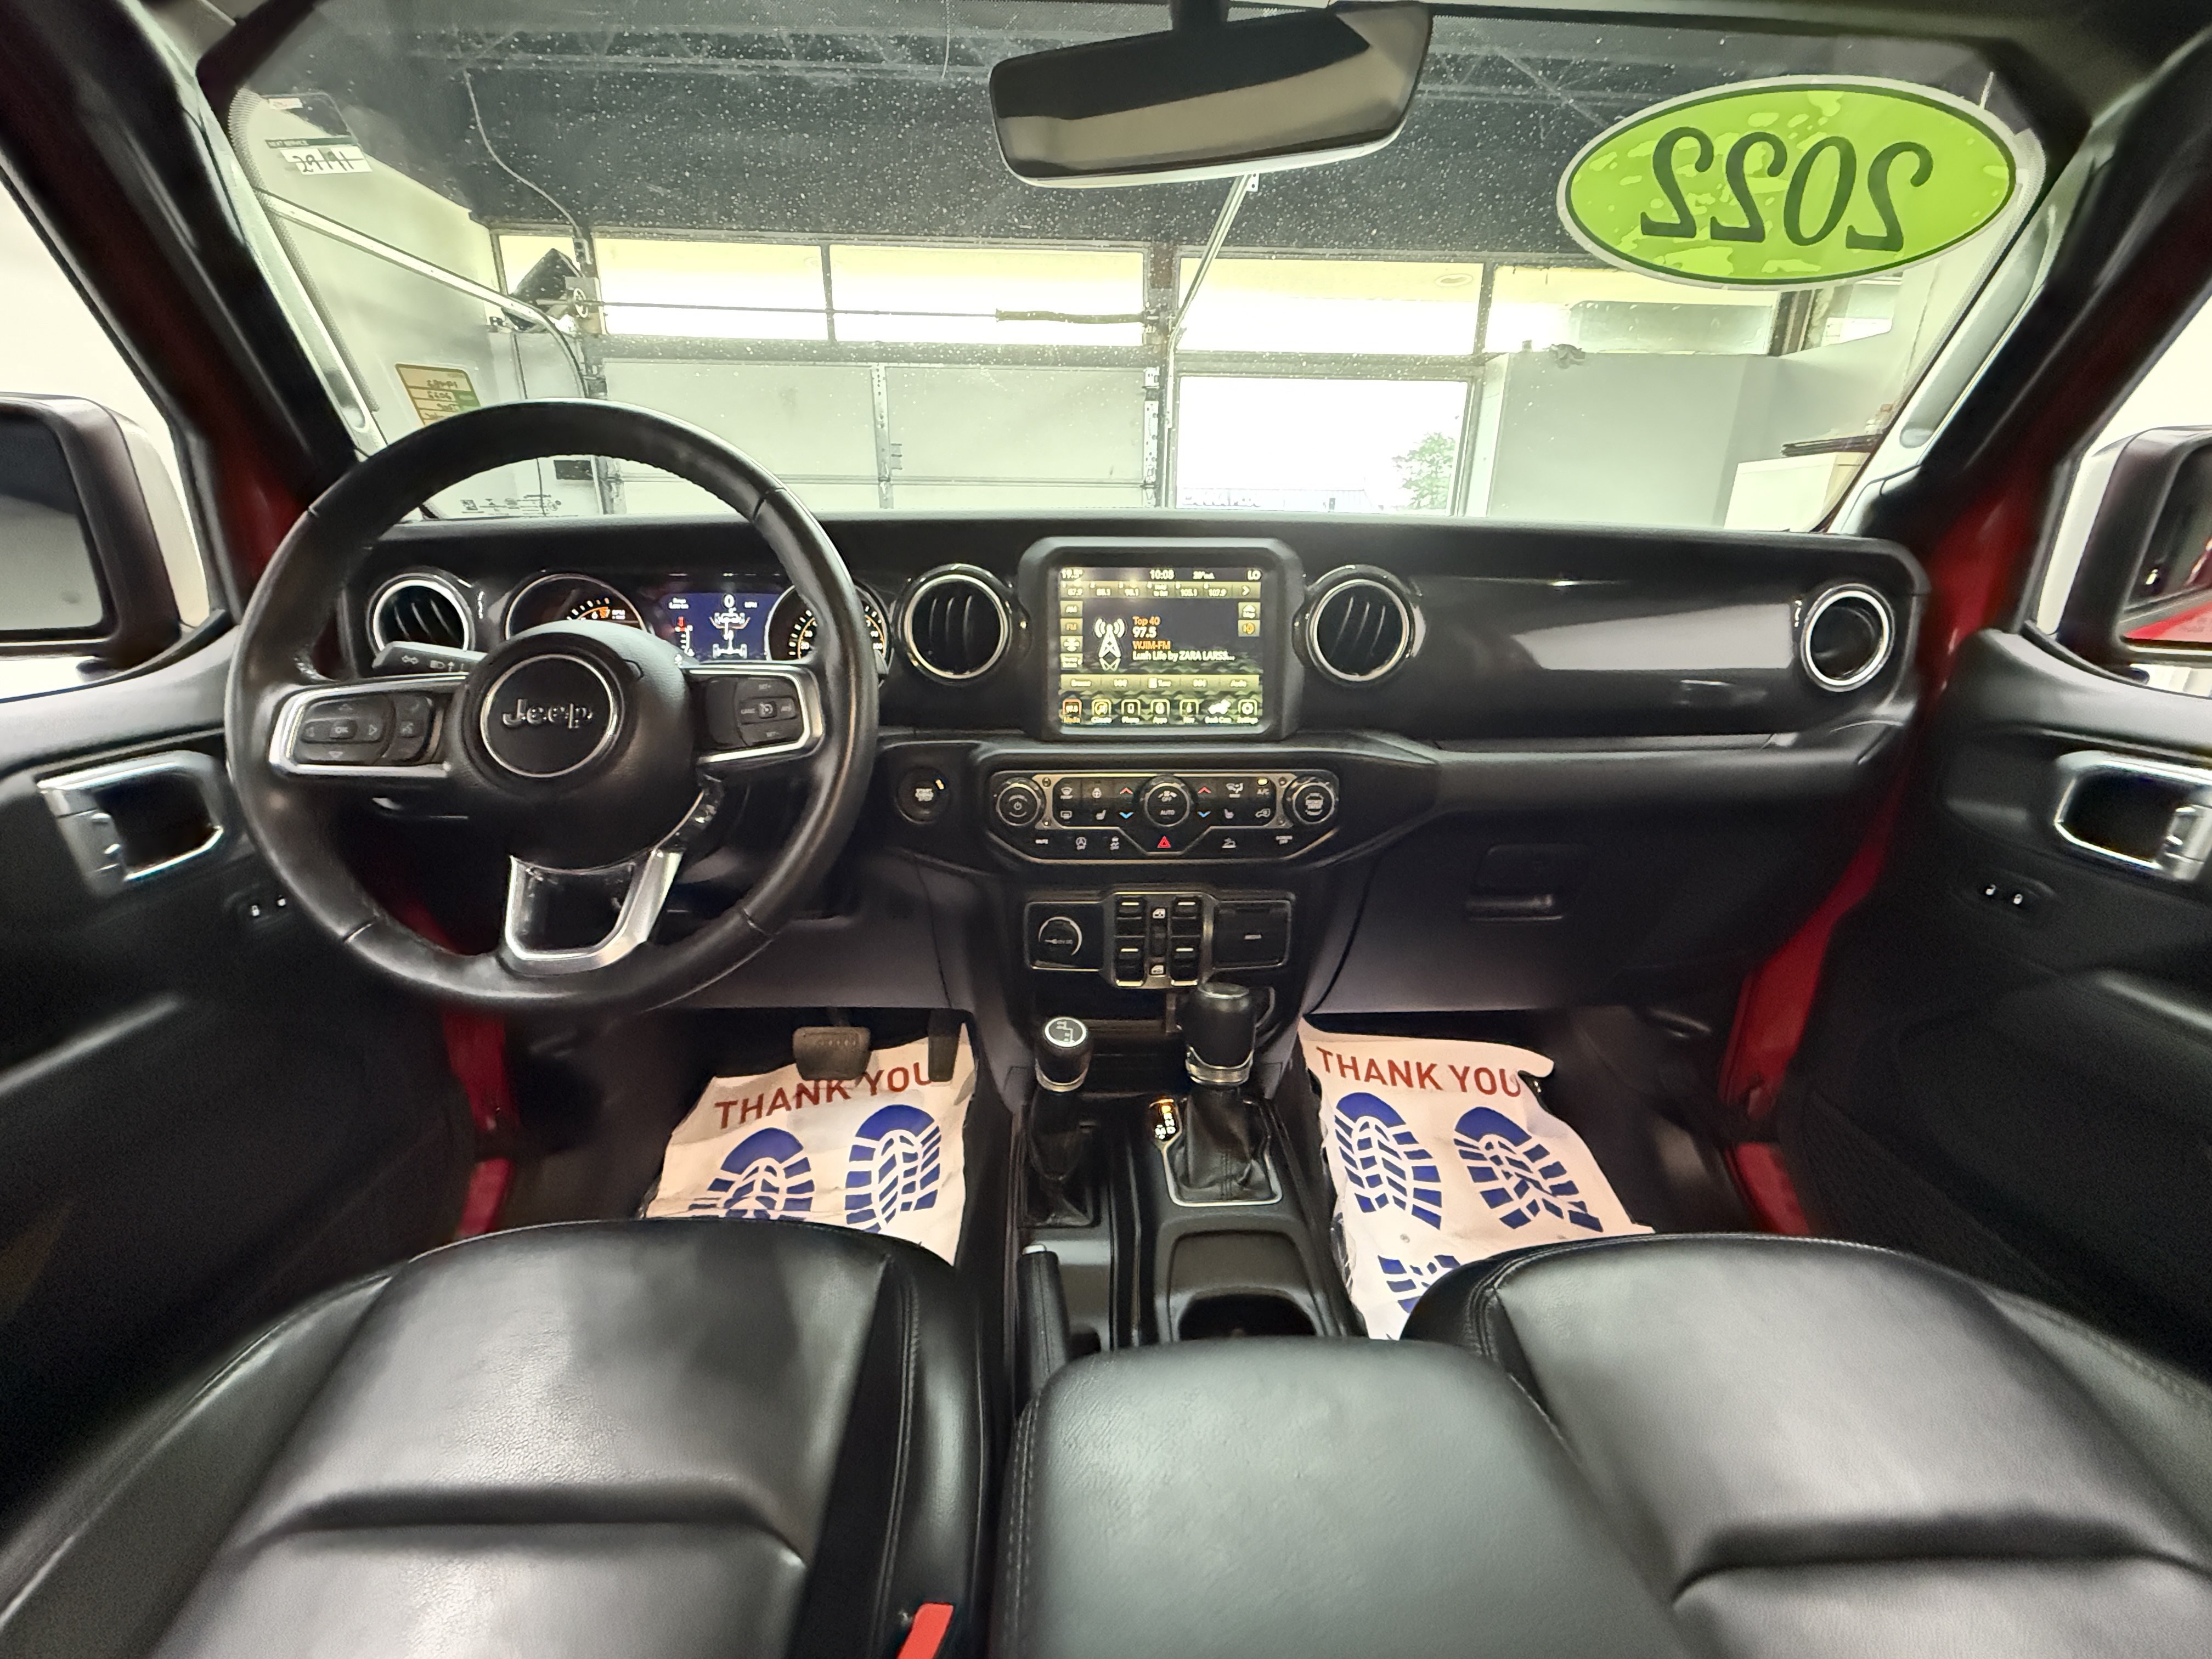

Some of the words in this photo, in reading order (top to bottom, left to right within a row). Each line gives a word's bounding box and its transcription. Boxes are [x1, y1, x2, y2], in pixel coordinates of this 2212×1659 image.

[724, 594, 735, 608] 0
[1132, 616, 1148, 626] Top
[1149, 616, 1161, 625] 40
[1132, 626, 1157, 638] 97.5
[1132, 640, 1171, 650] WJIM-FM
[1152, 651, 1167, 660] Life
[1167, 651, 1178, 662] by
[1179, 651, 1202, 661] ZARA
[502, 698, 593, 729] Jeep
[1316, 1046, 1443, 1091] THANK
[1449, 1063, 1522, 1097] YOU
[715, 1079, 850, 1129] THANK
